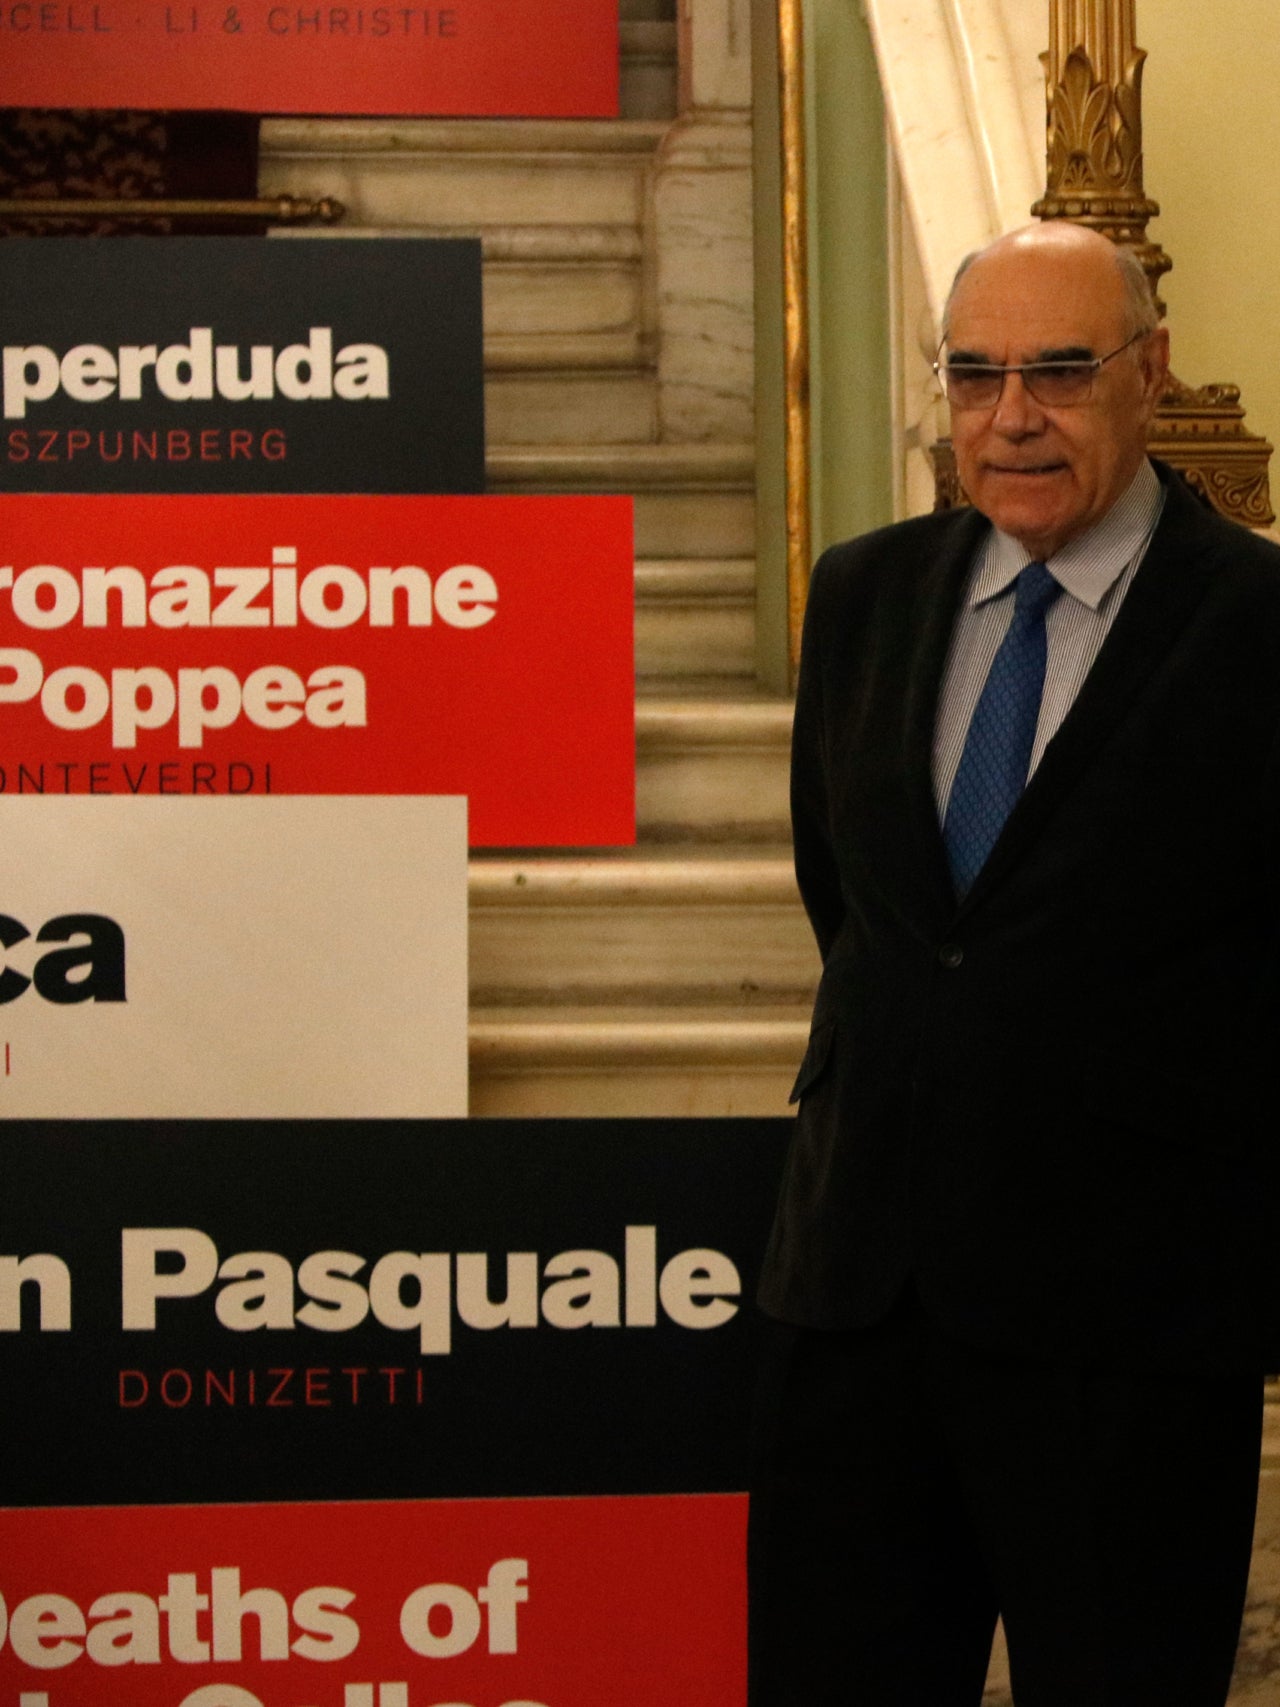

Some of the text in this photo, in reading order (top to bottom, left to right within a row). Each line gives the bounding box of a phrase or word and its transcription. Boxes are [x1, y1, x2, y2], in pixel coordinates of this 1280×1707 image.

[0, 4, 458, 37] CELL LI & CHRISTIE
[2, 327, 390, 419] perduda
[7, 429, 288, 462] SZPUNBERG
[0, 762, 271, 794] NTEVERDI
[121, 1225, 742, 1355] Pasquale
[118, 1368, 424, 1407] DONIZETTI
[0, 1557, 529, 1670] eaths of
